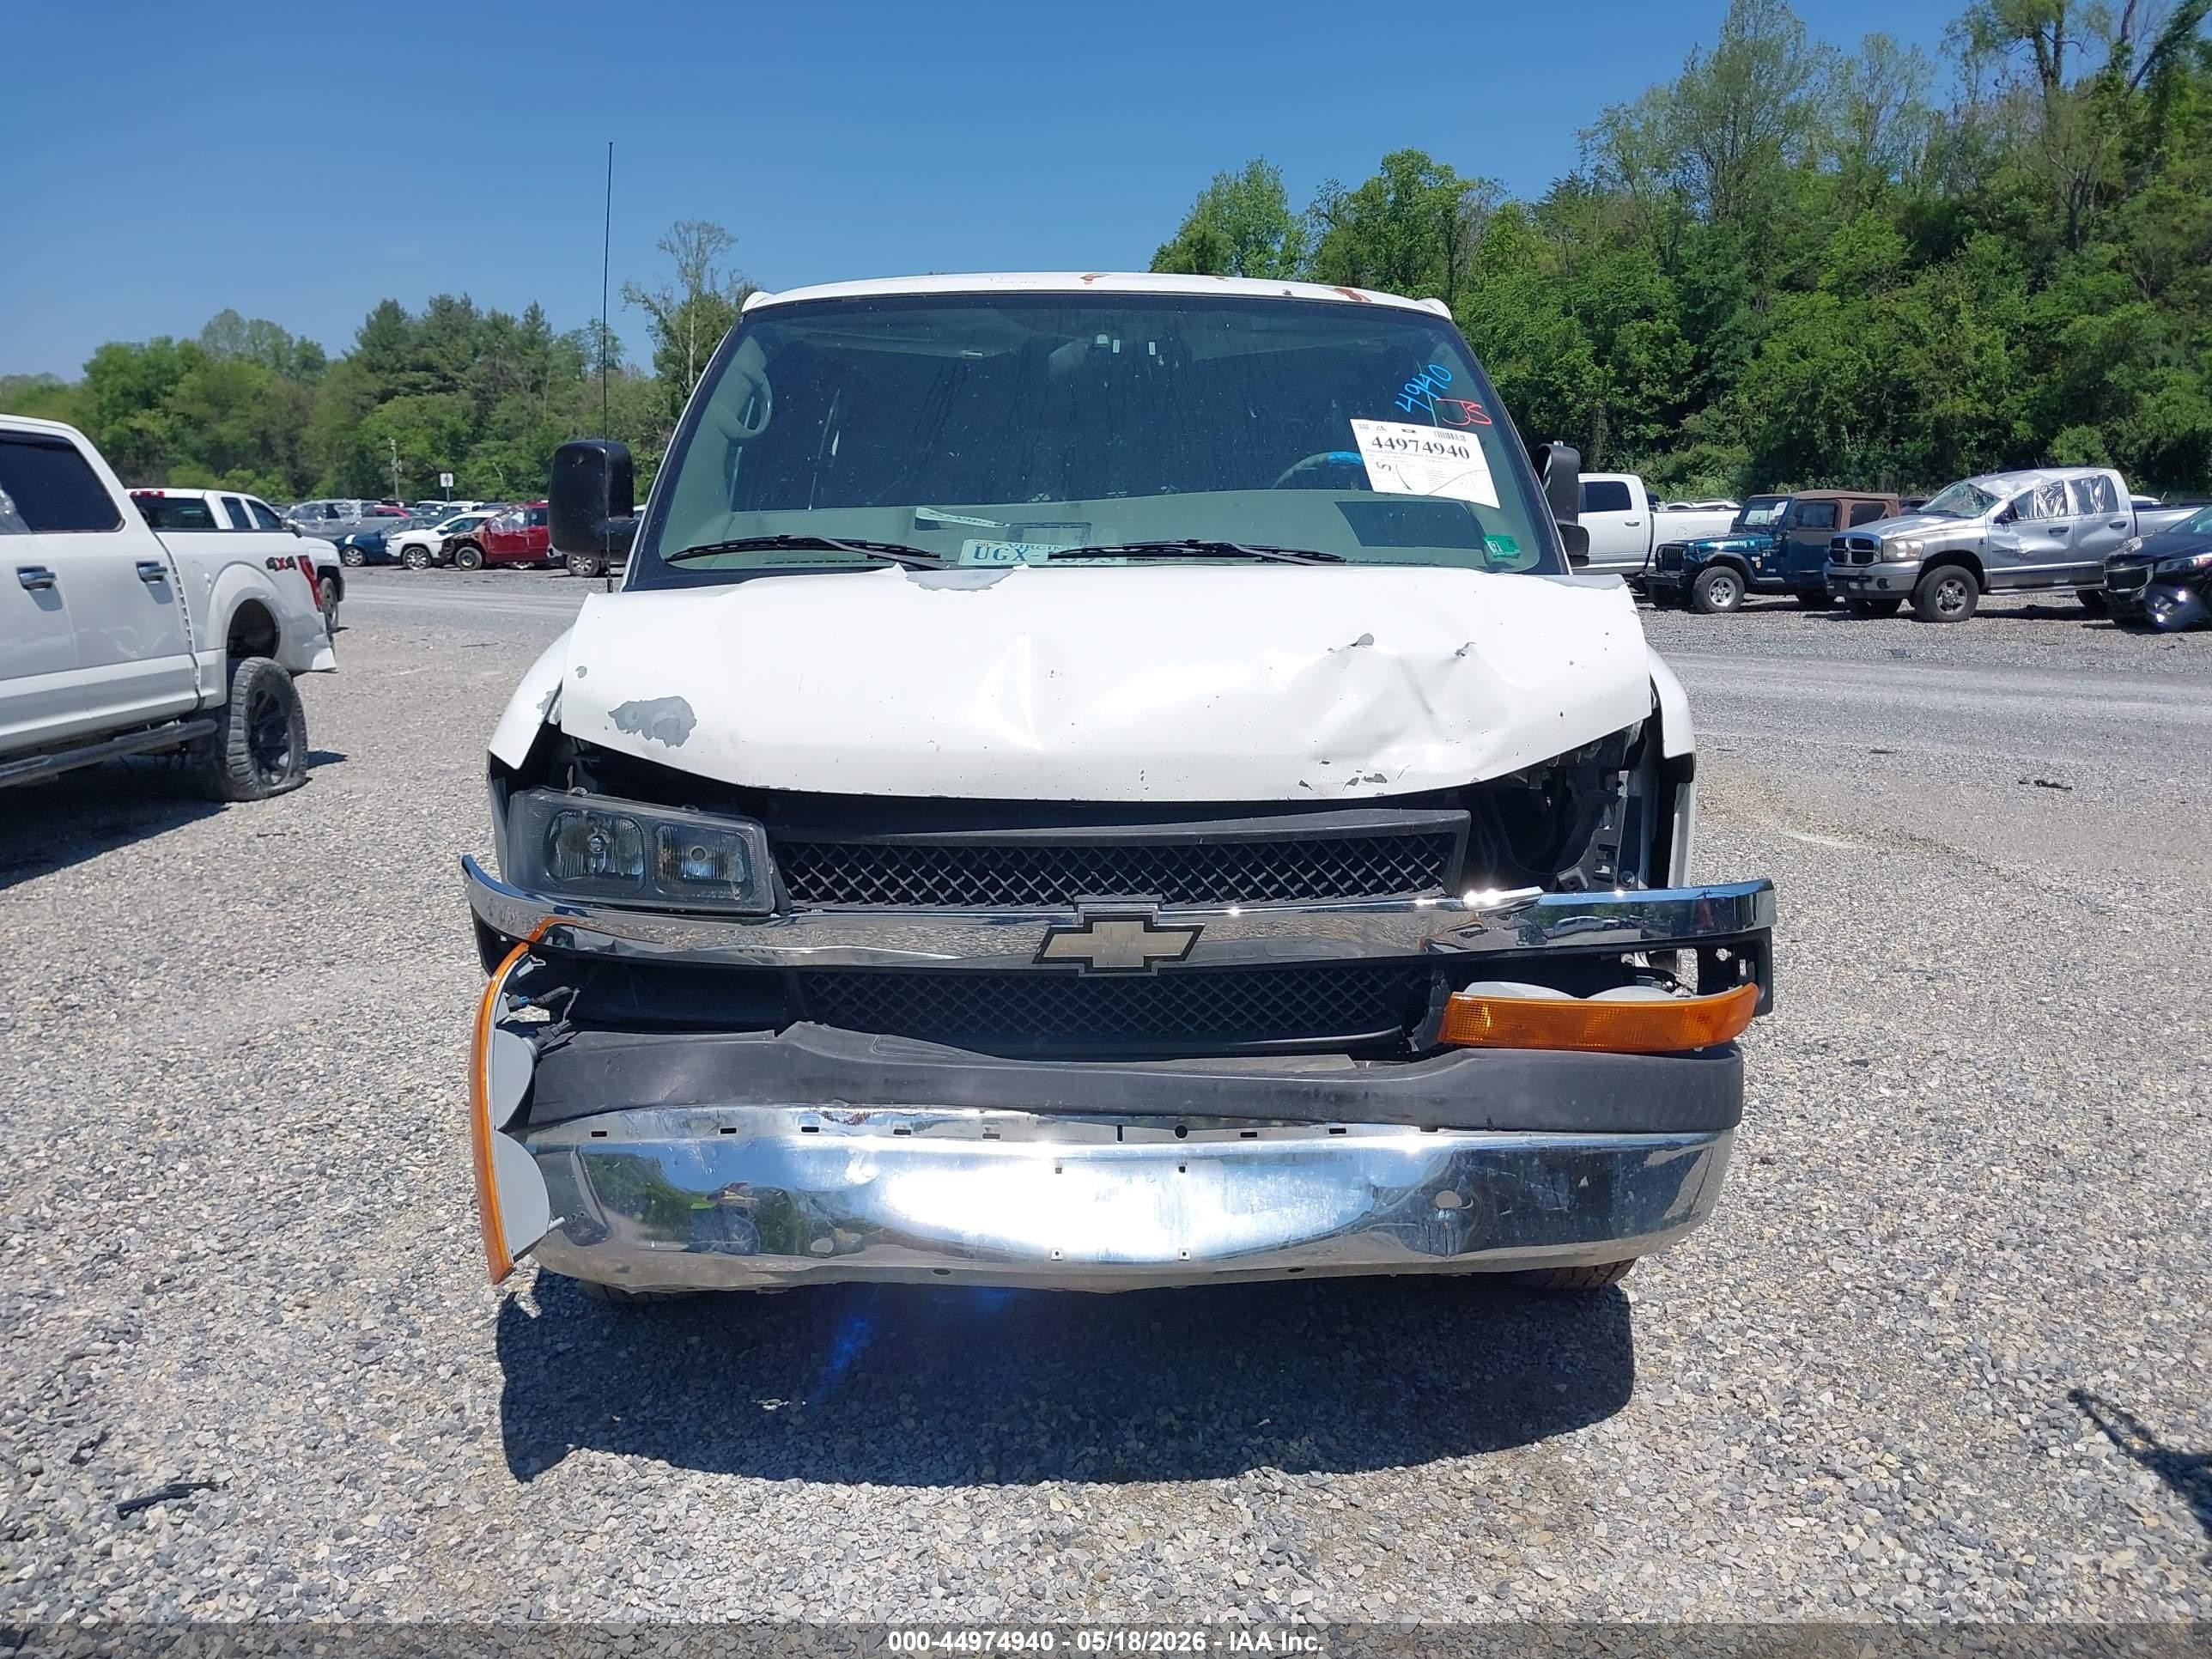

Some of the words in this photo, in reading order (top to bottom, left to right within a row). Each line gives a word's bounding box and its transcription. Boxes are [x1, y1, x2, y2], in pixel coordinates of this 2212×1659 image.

[1395, 364, 1452, 412] 4940
[1372, 436, 1470, 459] 44974940
[974, 545, 1116, 563] UGX-
[1008, 543, 1071, 551] VIRGIN
